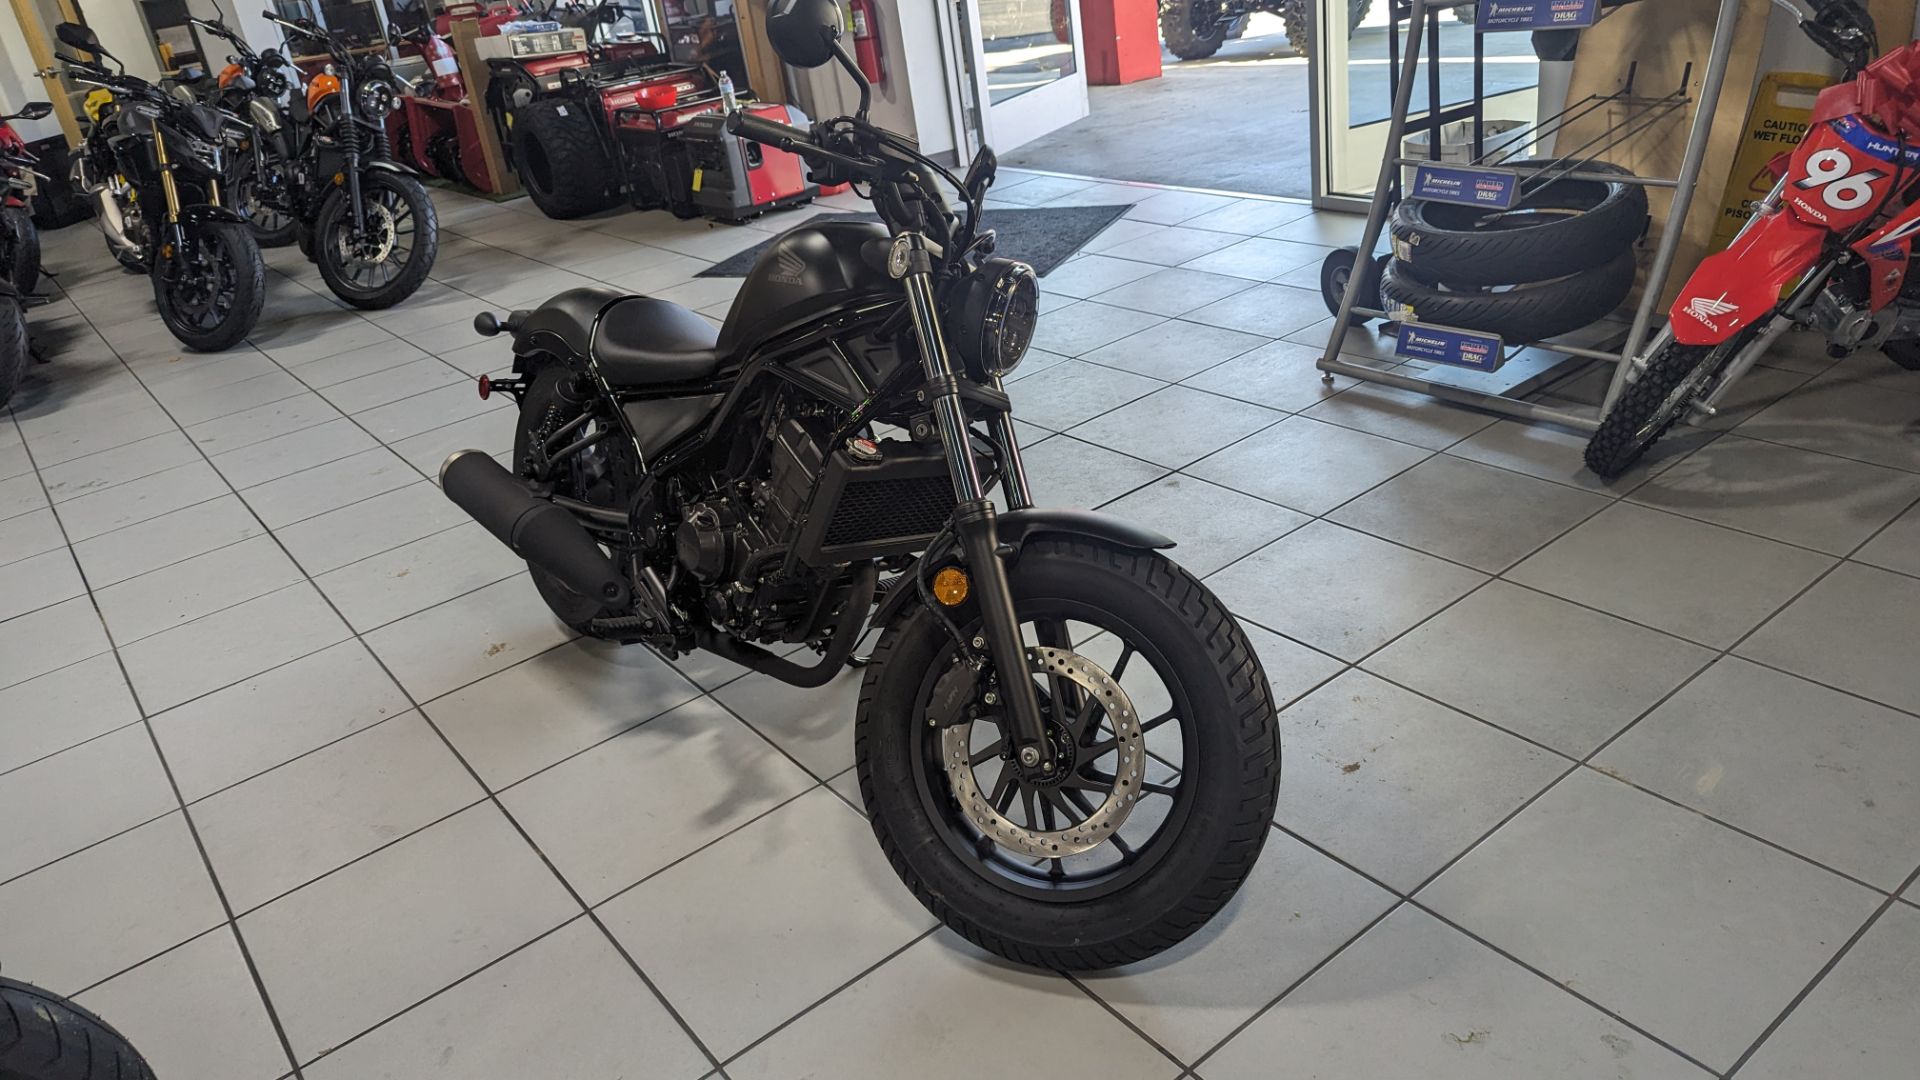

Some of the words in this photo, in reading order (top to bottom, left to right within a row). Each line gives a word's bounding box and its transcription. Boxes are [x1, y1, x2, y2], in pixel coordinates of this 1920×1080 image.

[1554, 11, 1577, 20] DRAG
[1763, 119, 1808, 133] CAUTIO
[1753, 129, 1778, 142] WET
[1779, 133, 1801, 145] FLO
[1867, 142, 1919, 160] HUNTER
[1431, 178, 1461, 186] MICHELIN
[1792, 147, 1890, 211] 96
[1477, 190, 1497, 199] DRAG
[1794, 197, 1828, 222] HONDA
[768, 273, 803, 286] HONDA
[1682, 306, 1718, 333] HONDA
[1415, 337, 1446, 347] MICHELIN
[1462, 352, 1483, 361] DRAG
